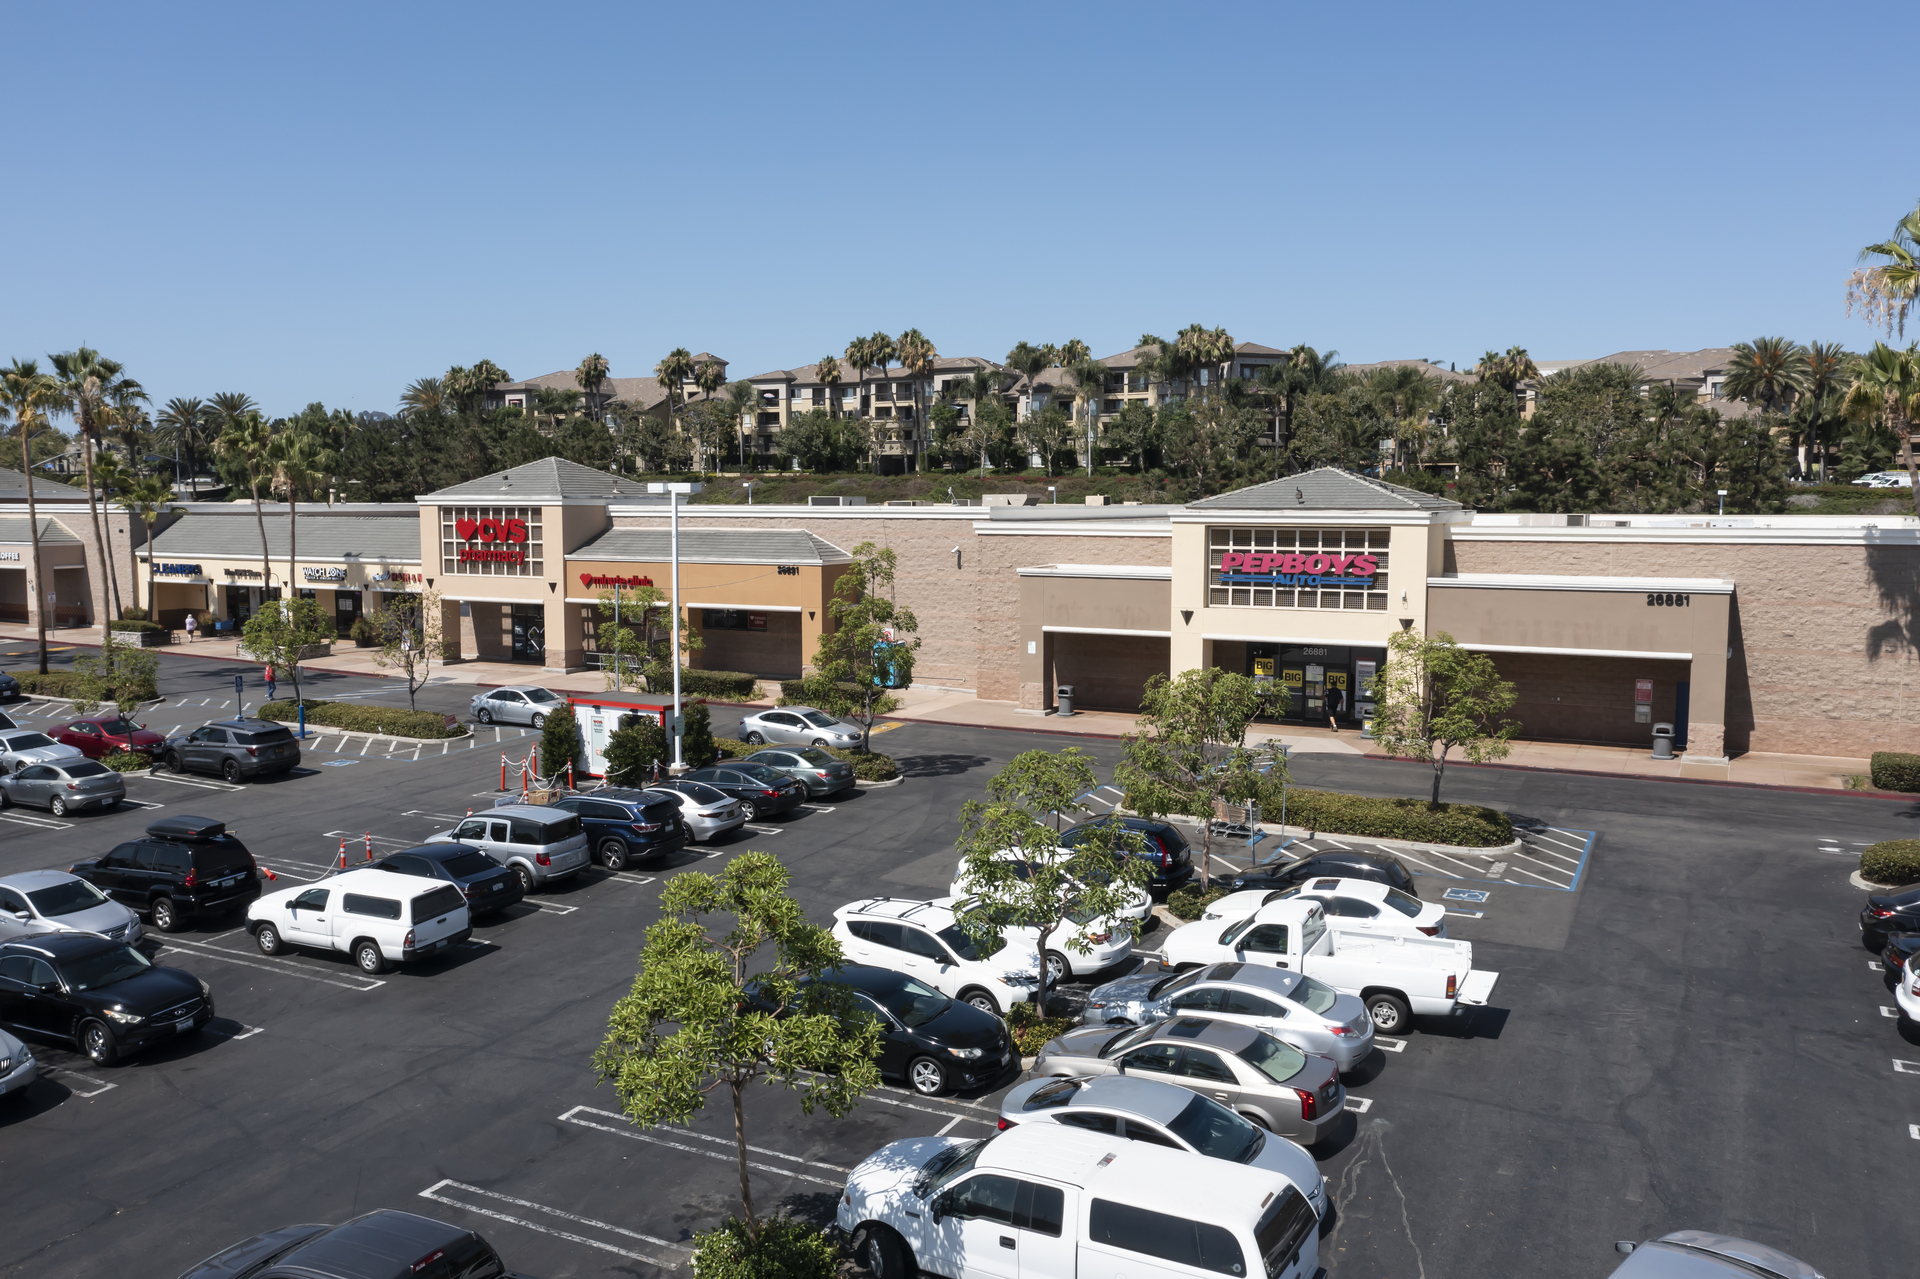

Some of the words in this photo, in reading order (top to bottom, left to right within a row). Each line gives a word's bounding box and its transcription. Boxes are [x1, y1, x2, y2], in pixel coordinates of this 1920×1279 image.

[477, 518, 527, 543] CVS
[460, 546, 525, 565] pharmacy
[153, 562, 202, 575] CLEANERS
[302, 567, 326, 577] WATCH
[327, 567, 346, 578] ZONE
[593, 574, 626, 585] minute
[627, 575, 653, 587] clinic
[1271, 574, 1322, 586] AUTO
[1646, 593, 1690, 607] 26881
[1302, 646, 1328, 656] 26881
[1256, 660, 1273, 670] BIG
[1284, 672, 1302, 682] BIG
[1328, 674, 1346, 685] BIG
